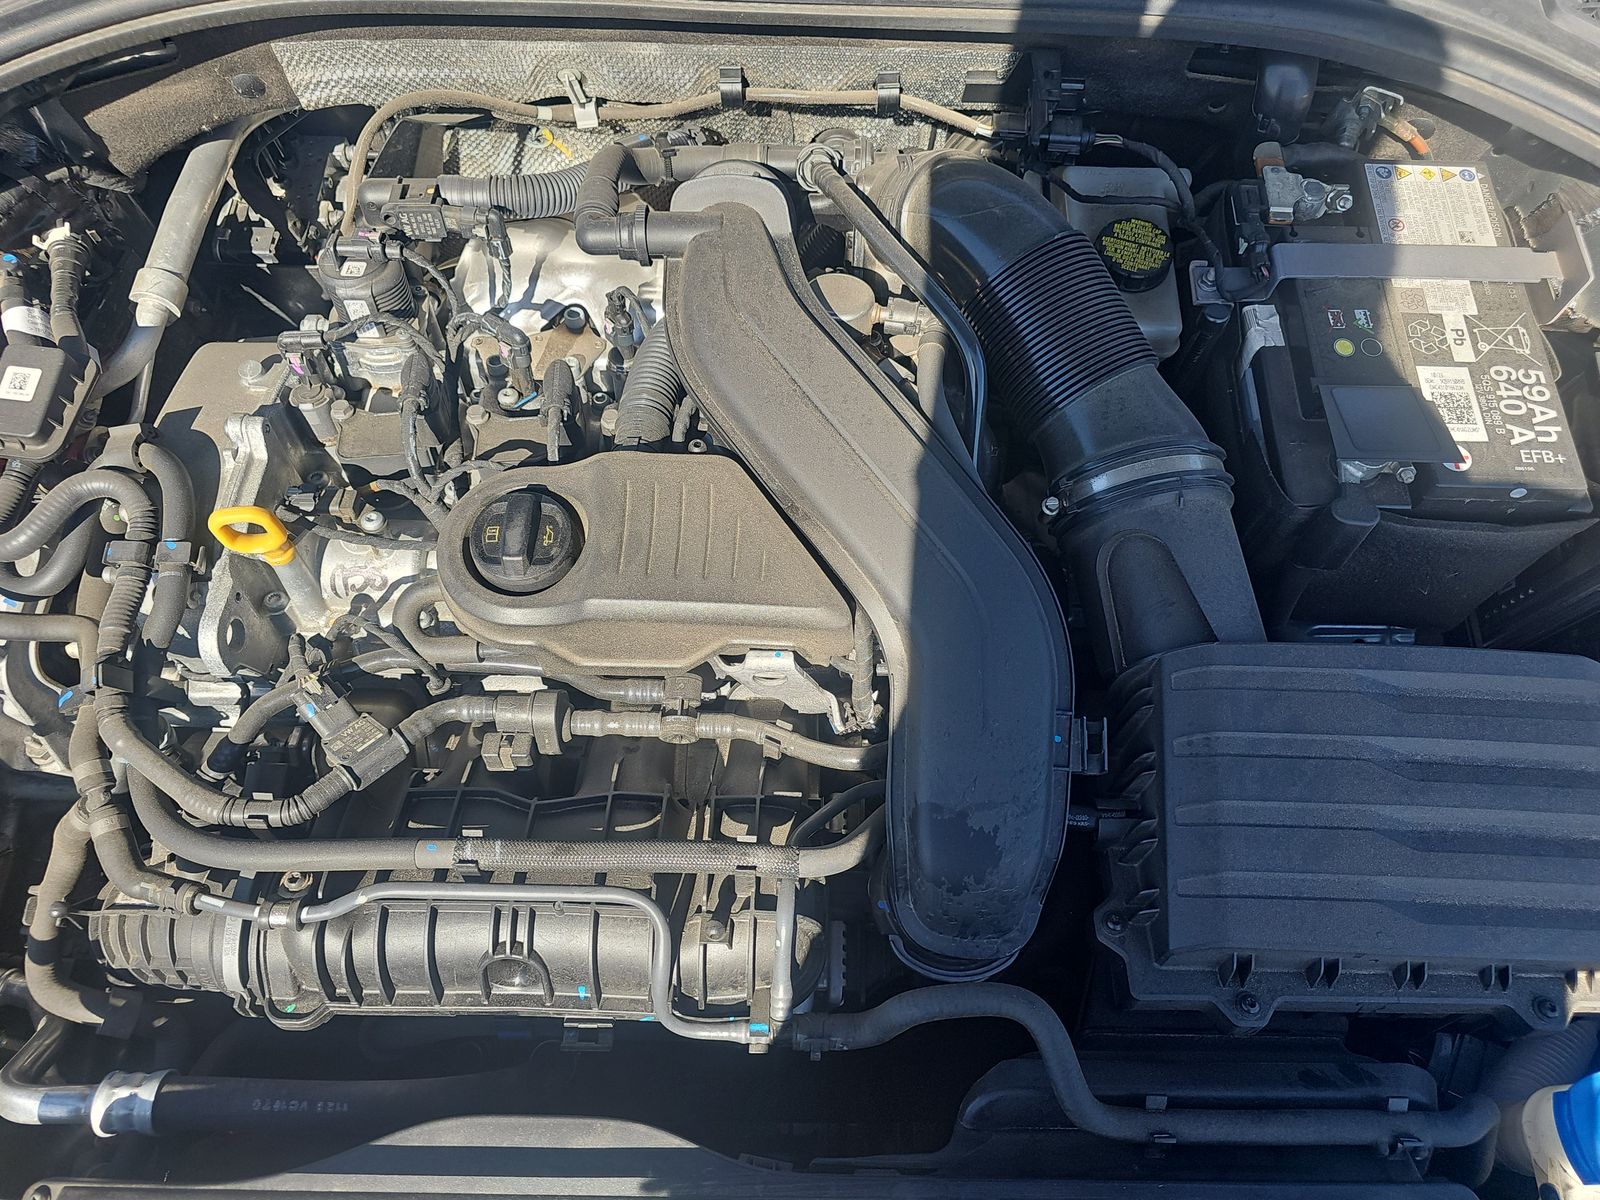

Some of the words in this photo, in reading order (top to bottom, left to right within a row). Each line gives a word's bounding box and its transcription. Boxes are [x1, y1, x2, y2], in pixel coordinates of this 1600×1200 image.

[1450, 328, 1464, 347] Pb
[1490, 365, 1528, 416] 640
[1486, 394, 1499, 408] 915
[1517, 368, 1563, 443] 59Ah
[1483, 412, 1493, 425] DIN
[1504, 423, 1536, 446] A
[1520, 449, 1566, 464] EFB+
